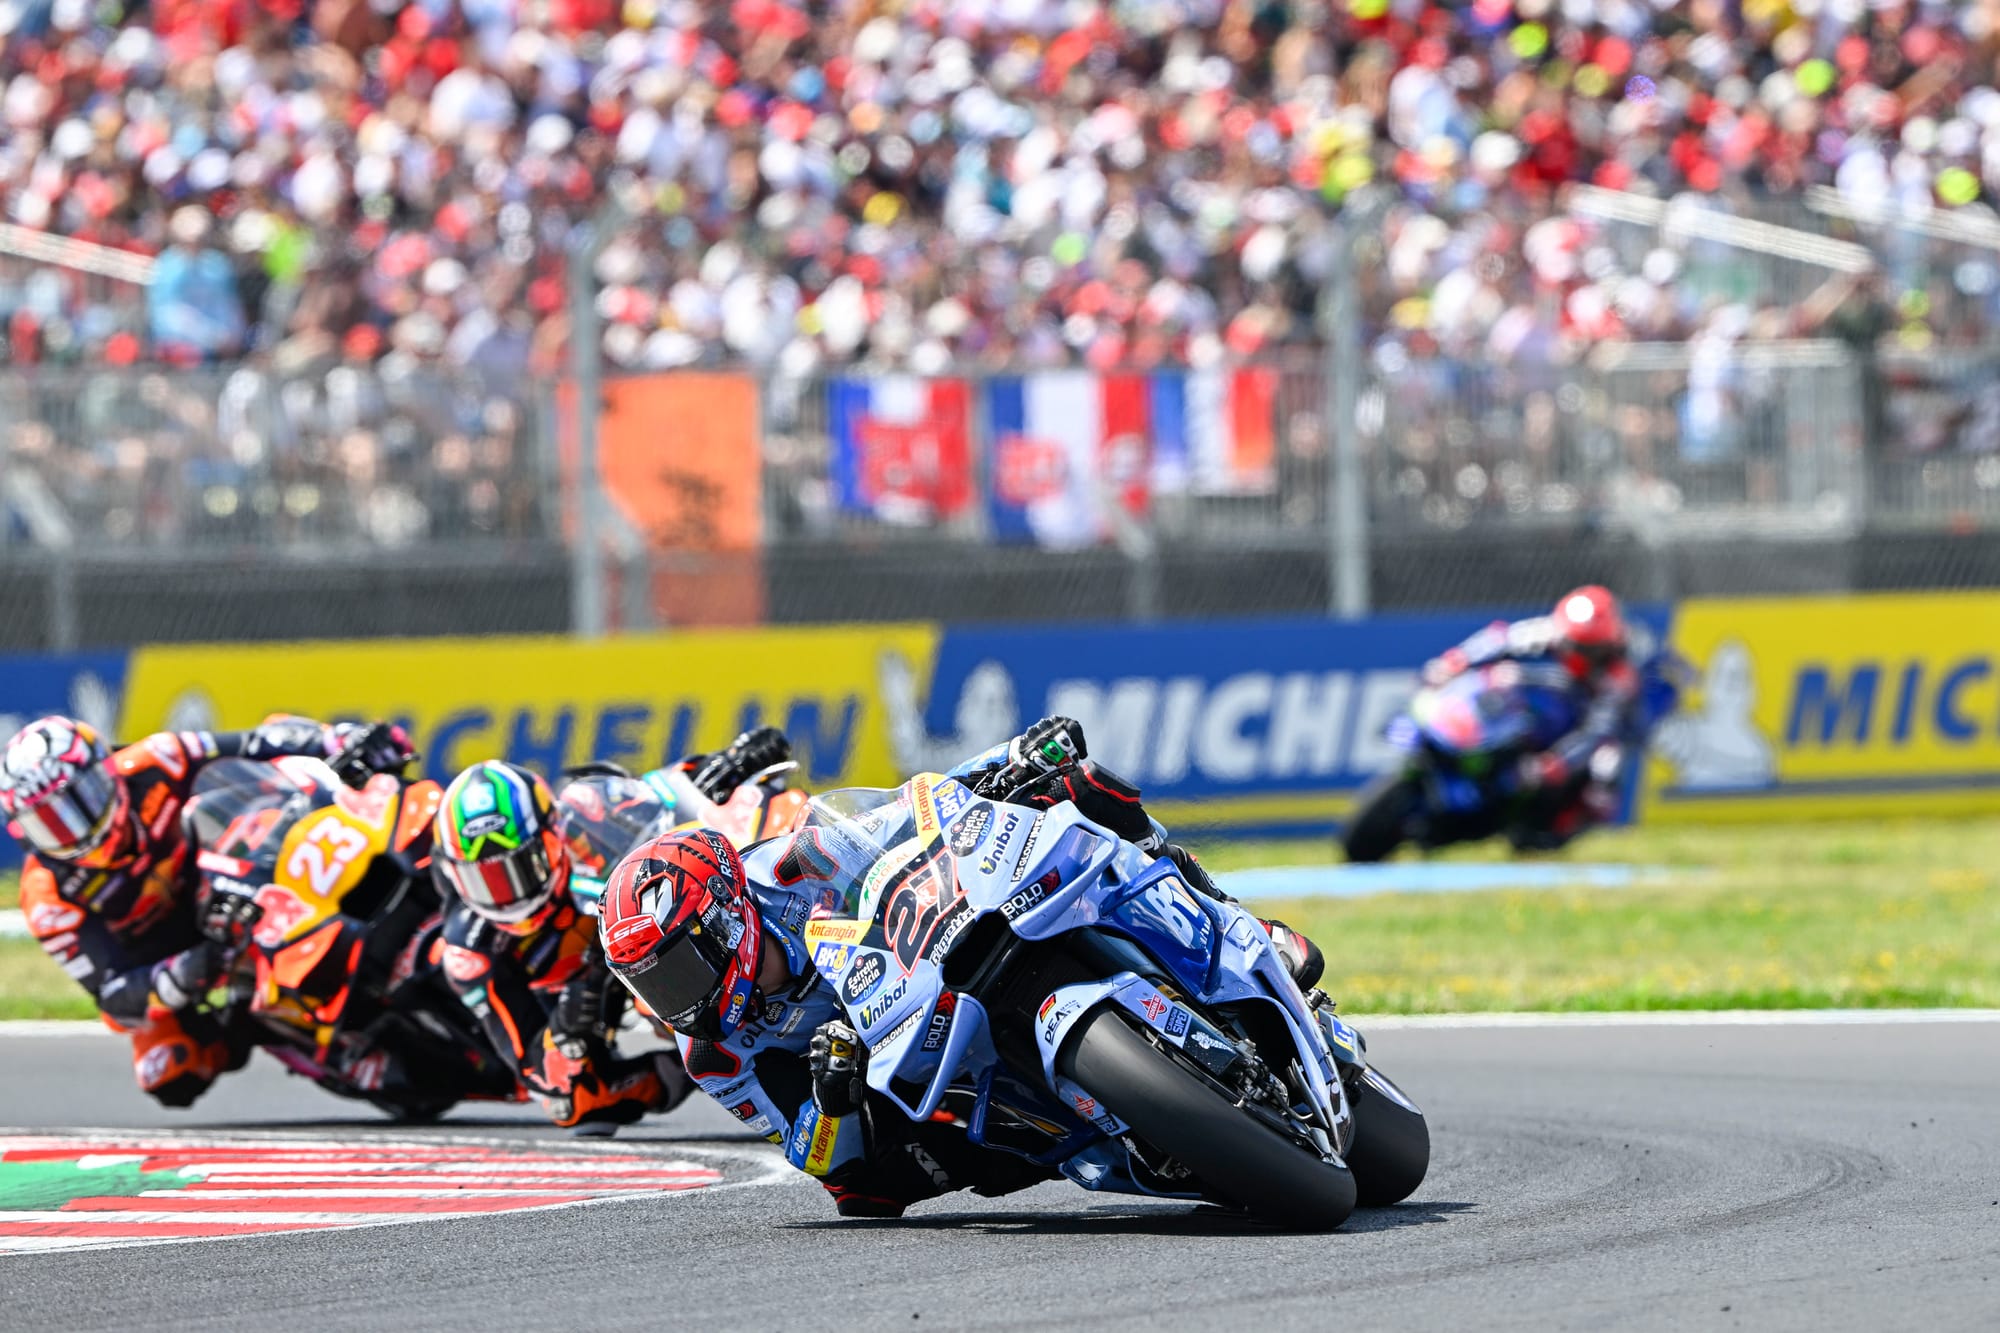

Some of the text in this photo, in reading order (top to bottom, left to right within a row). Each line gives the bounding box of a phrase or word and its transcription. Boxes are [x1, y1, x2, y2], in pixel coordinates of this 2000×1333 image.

[1786, 656, 2000, 747] MIC
[328, 692, 860, 788] CHELN
[1044, 668, 1424, 786] MICHE
[936, 780, 961, 819] BK8
[955, 809, 980, 847] Estrella
[965, 811, 989, 847] Galicia
[979, 812, 1019, 875] Unibat
[287, 815, 369, 898] 23
[868, 860, 887, 886] AUS
[1000, 883, 1043, 917] BOLD
[606, 917, 653, 944] LS2
[790, 900, 810, 935] Unibat
[809, 922, 857, 940] Antangin
[816, 945, 848, 972] BK8
[847, 957, 878, 989] Estrella
[851, 968, 881, 998] Galicia
[727, 992, 745, 1024] BK8
[859, 975, 909, 1030] Unibat
[924, 1015, 946, 1049] BOLD
[1172, 1010, 1189, 1034] SIPEX
[802, 1105, 816, 1131] NEW
[810, 1114, 833, 1167] Antangin
